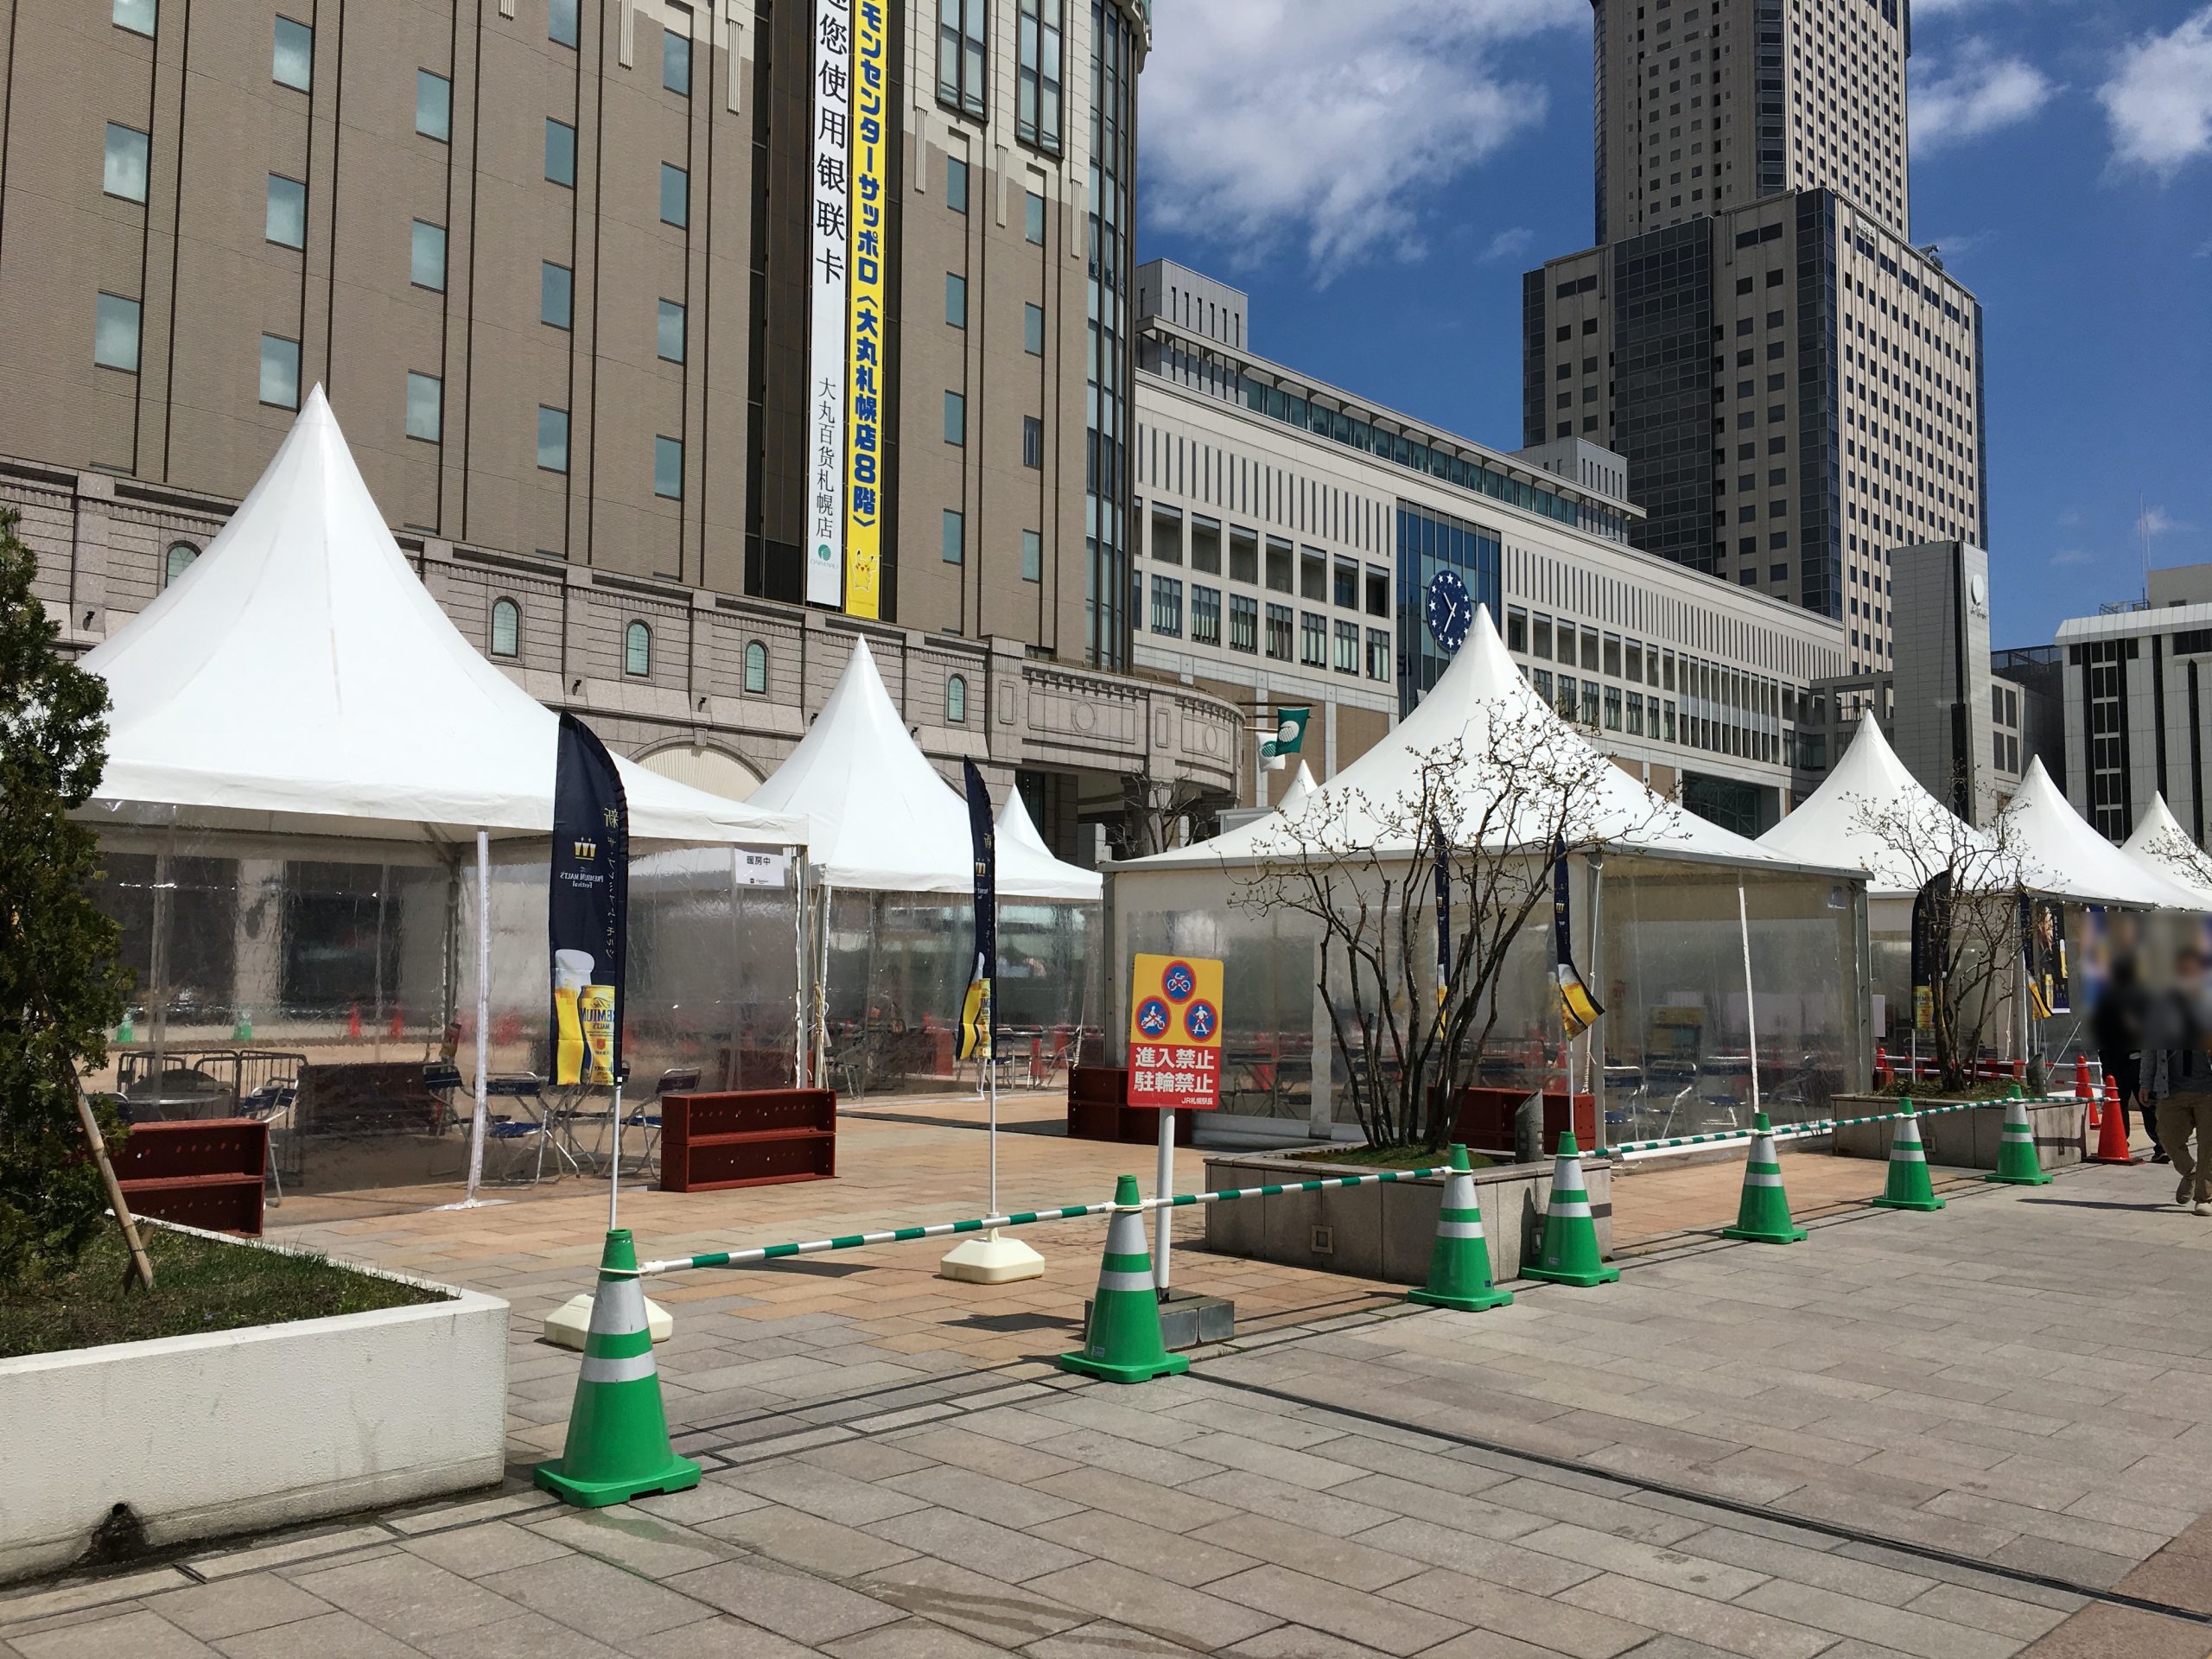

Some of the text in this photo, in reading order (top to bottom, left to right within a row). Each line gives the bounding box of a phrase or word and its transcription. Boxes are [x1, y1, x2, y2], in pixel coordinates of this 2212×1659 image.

[816, 377, 836, 540] 大丸百货札幌店
[1135, 1046, 1215, 1071] 進入禁止
[1134, 1071, 1214, 1094] 駐輪禁止
